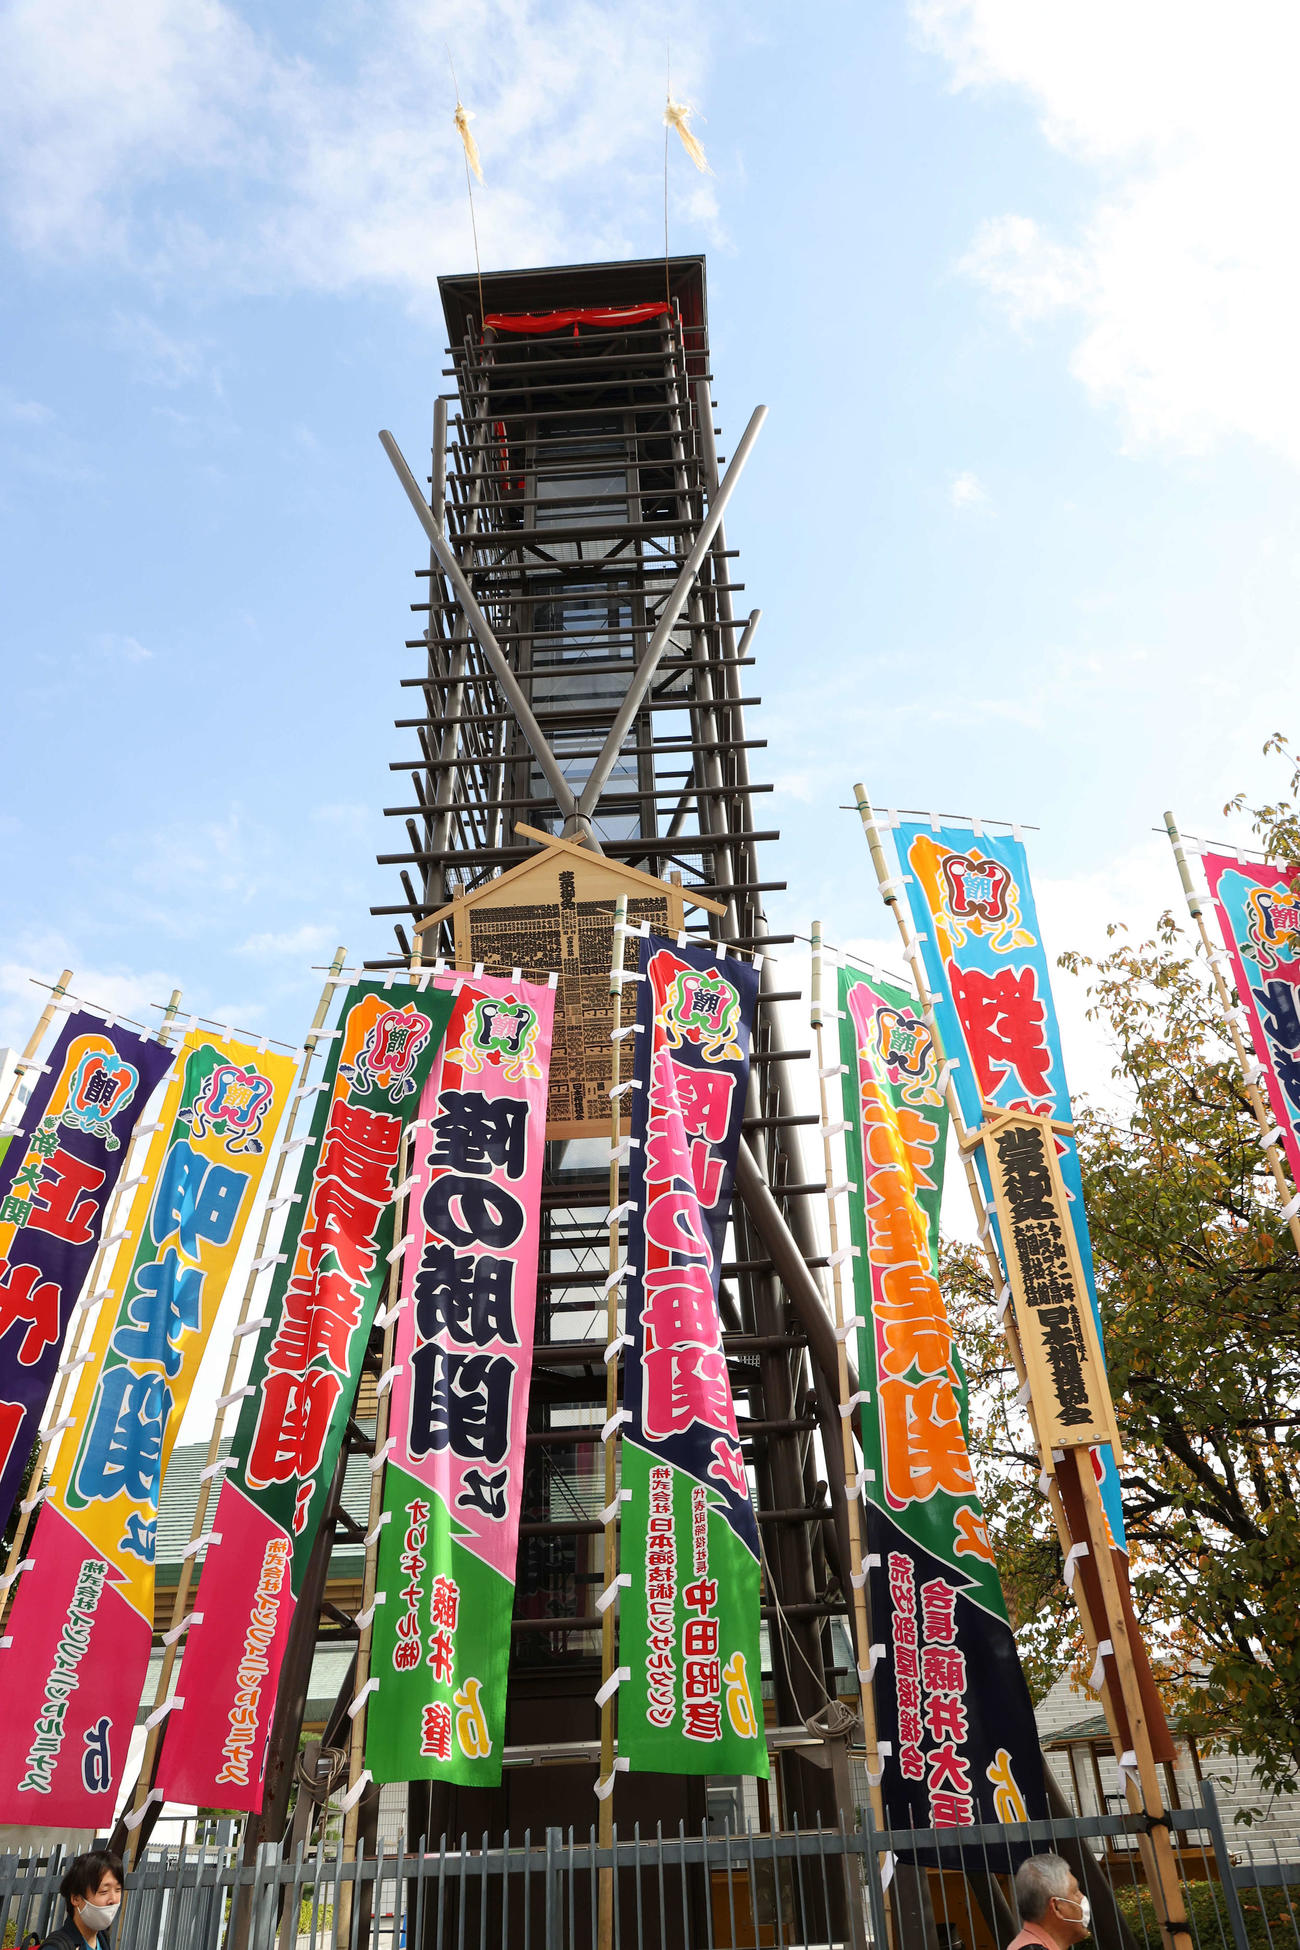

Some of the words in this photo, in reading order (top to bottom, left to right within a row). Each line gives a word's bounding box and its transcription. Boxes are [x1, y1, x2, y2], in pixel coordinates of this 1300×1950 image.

[994, 1126, 1059, 1226] 蒙御免
[1036, 1304, 1094, 1427] 日本相撲協会
